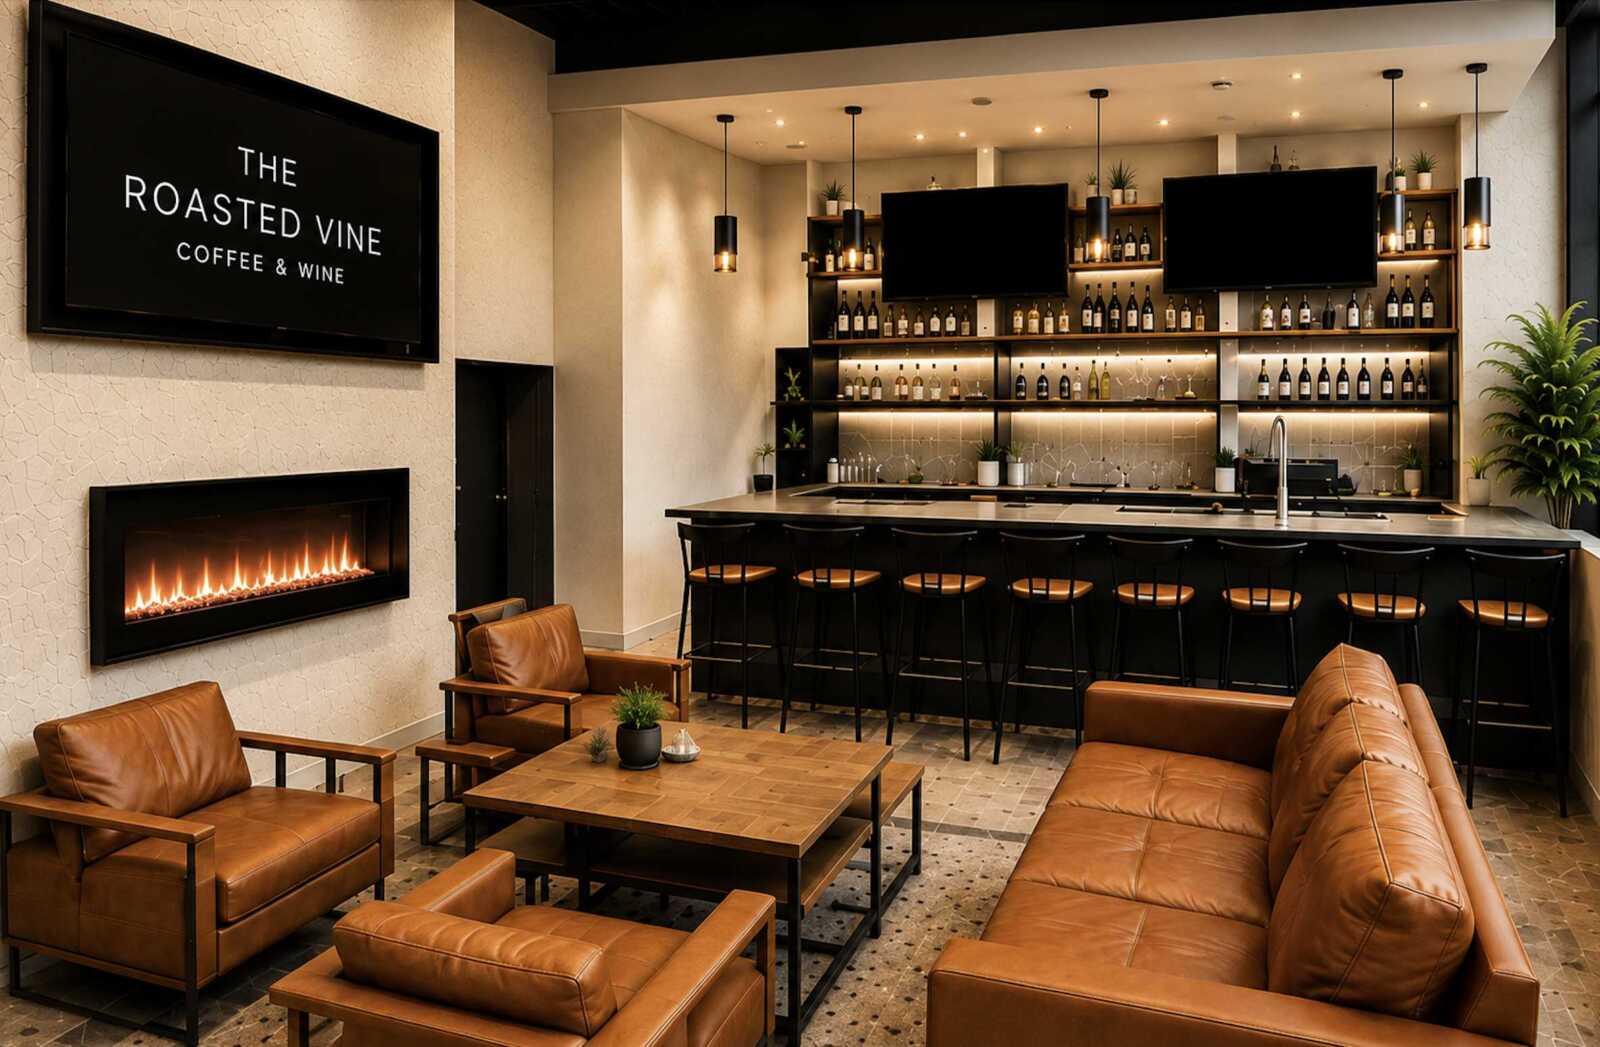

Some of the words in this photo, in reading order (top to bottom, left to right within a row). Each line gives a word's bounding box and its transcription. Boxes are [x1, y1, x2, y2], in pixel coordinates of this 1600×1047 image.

[237, 145, 297, 188] THE
[125, 174, 301, 239] ROASTED
[315, 215, 382, 256] VINE
[176, 241, 264, 272] COFFEE
[275, 257, 287, 276] &
[297, 261, 344, 285] WINE
